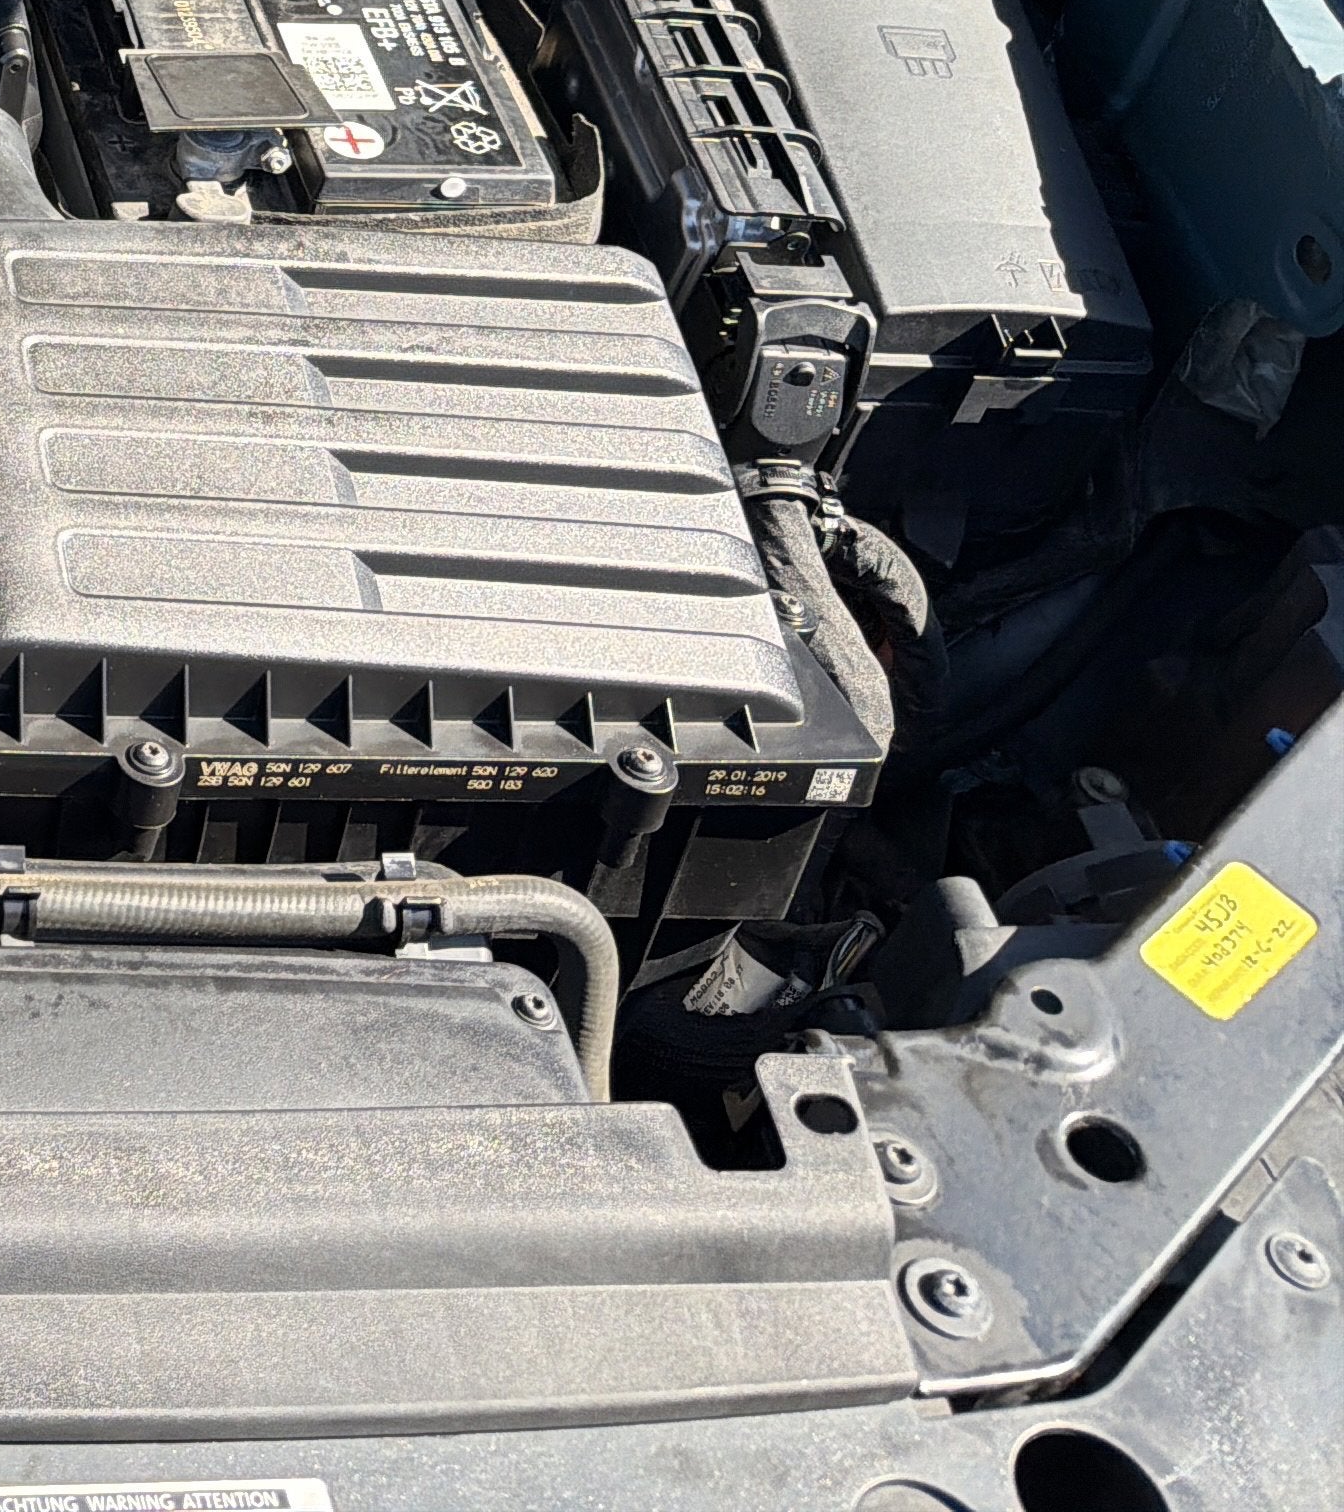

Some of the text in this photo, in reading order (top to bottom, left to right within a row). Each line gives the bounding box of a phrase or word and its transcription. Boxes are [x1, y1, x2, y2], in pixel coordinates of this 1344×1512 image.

[361, 7, 400, 52] EFB+
[394, 87, 417, 105] Pb
[201, 761, 259, 776] VWAG
[299, 763, 322, 774] 129
[325, 763, 353, 774] 607
[504, 766, 528, 777] 129
[531, 766, 559, 778] 620
[261, 776, 284, 787] 129
[287, 776, 312, 788] 601
[707, 769, 788, 782] 29.01.2019
[499, 779, 523, 790] 183
[705, 784, 767, 796] 15:02:16
[85, 1494, 175, 1511] WARNING
[182, 1491, 279, 1509] ATTENTION
